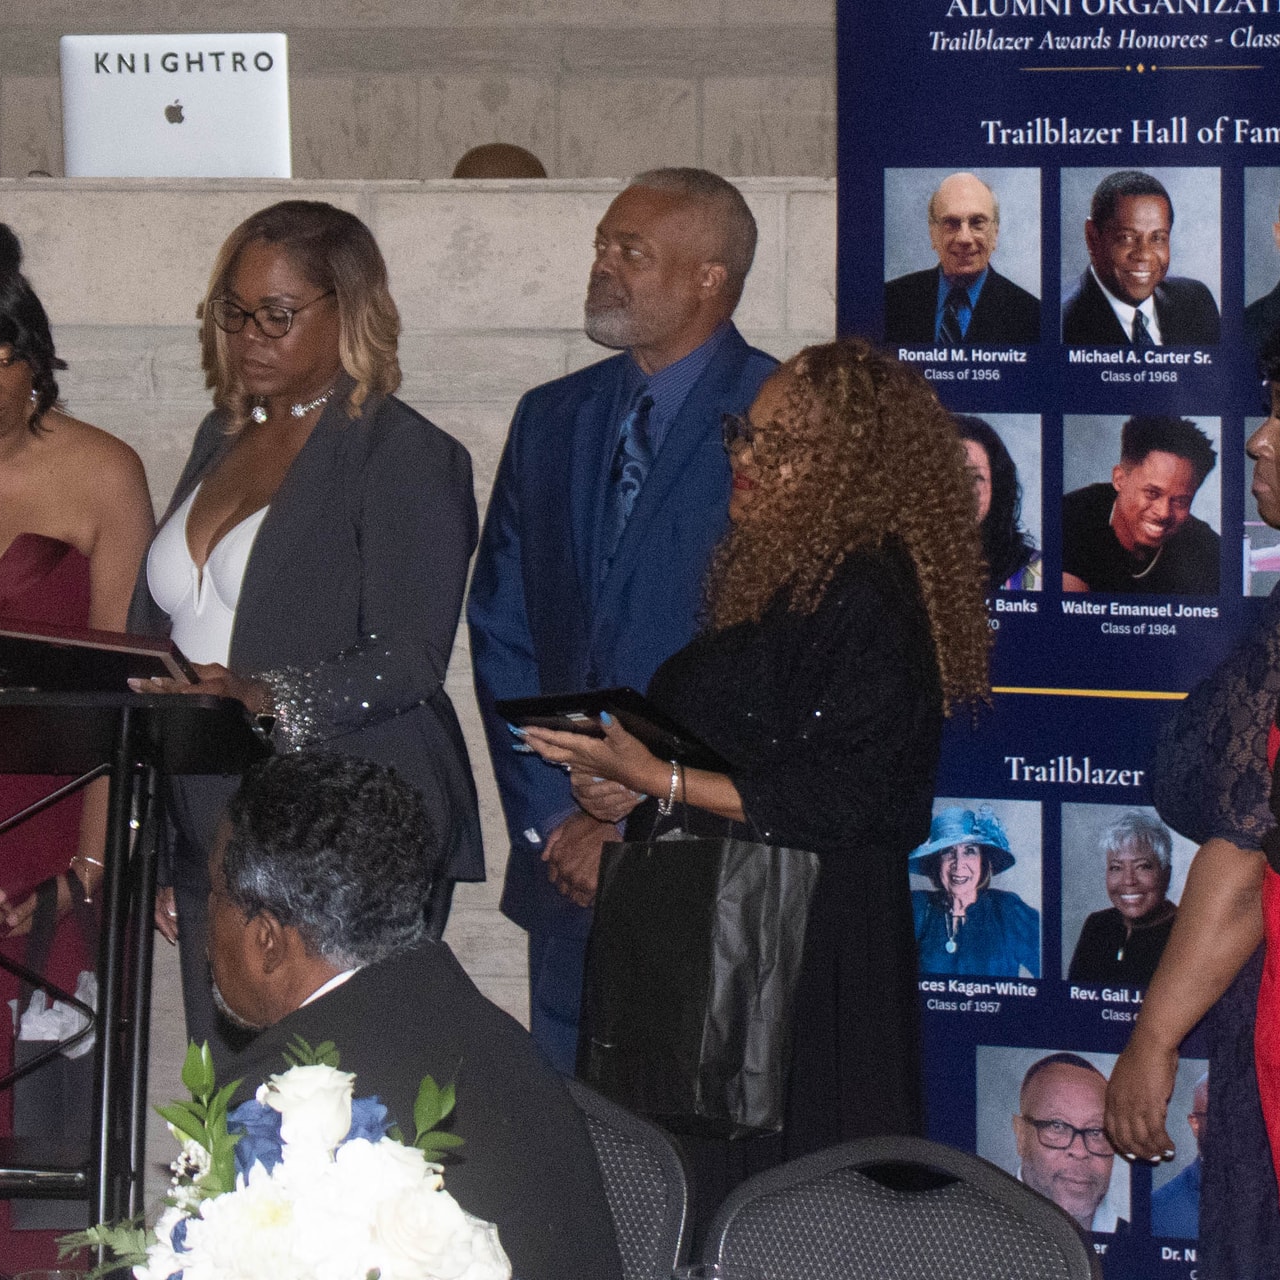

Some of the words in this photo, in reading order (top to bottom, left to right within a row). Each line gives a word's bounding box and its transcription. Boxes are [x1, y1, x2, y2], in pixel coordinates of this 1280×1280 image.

[929, 28, 1034, 52] Trailblazer
[1038, 27, 1112, 51] Awards
[1118, 27, 1209, 49] Honorees
[94, 51, 274, 74] KNIGHTRO
[980, 117, 1123, 146] Trailblazer
[1132, 116, 1188, 145] Hall
[1196, 115, 1230, 144] of
[898, 348, 947, 363] Ronald
[950, 348, 968, 363] M.
[971, 348, 1027, 363] Horwitz
[1068, 349, 1122, 365] Michael
[1125, 350, 1141, 365] A.
[1144, 350, 1190, 365] Carter
[1193, 350, 1212, 365] Sr.
[923, 368, 955, 382] Class
[957, 368, 969, 382] of
[970, 368, 1001, 381] 1956
[1100, 370, 1132, 384] Class
[1134, 370, 1146, 384] of
[1148, 370, 1179, 383] 1968
[995, 598, 1039, 613] Banks
[1061, 600, 1107, 616] Walter
[1109, 601, 1172, 617] Emanuel
[1174, 603, 1219, 618] Jones
[1100, 622, 1131, 636] Class
[1133, 622, 1146, 636] of
[1148, 623, 1177, 636] 1984
[1004, 755, 1145, 788] Trailblazer
[948, 980, 1037, 997] Kagan-White
[1070, 986, 1100, 1001] Rev.
[1101, 988, 1129, 1002] Gail
[1131, 989, 1144, 1003] J.
[926, 998, 957, 1012] Class
[959, 999, 972, 1012] of
[973, 1001, 1001, 1014] 1957
[1101, 1008, 1132, 1022] Class
[1161, 1246, 1182, 1262] Dr.
